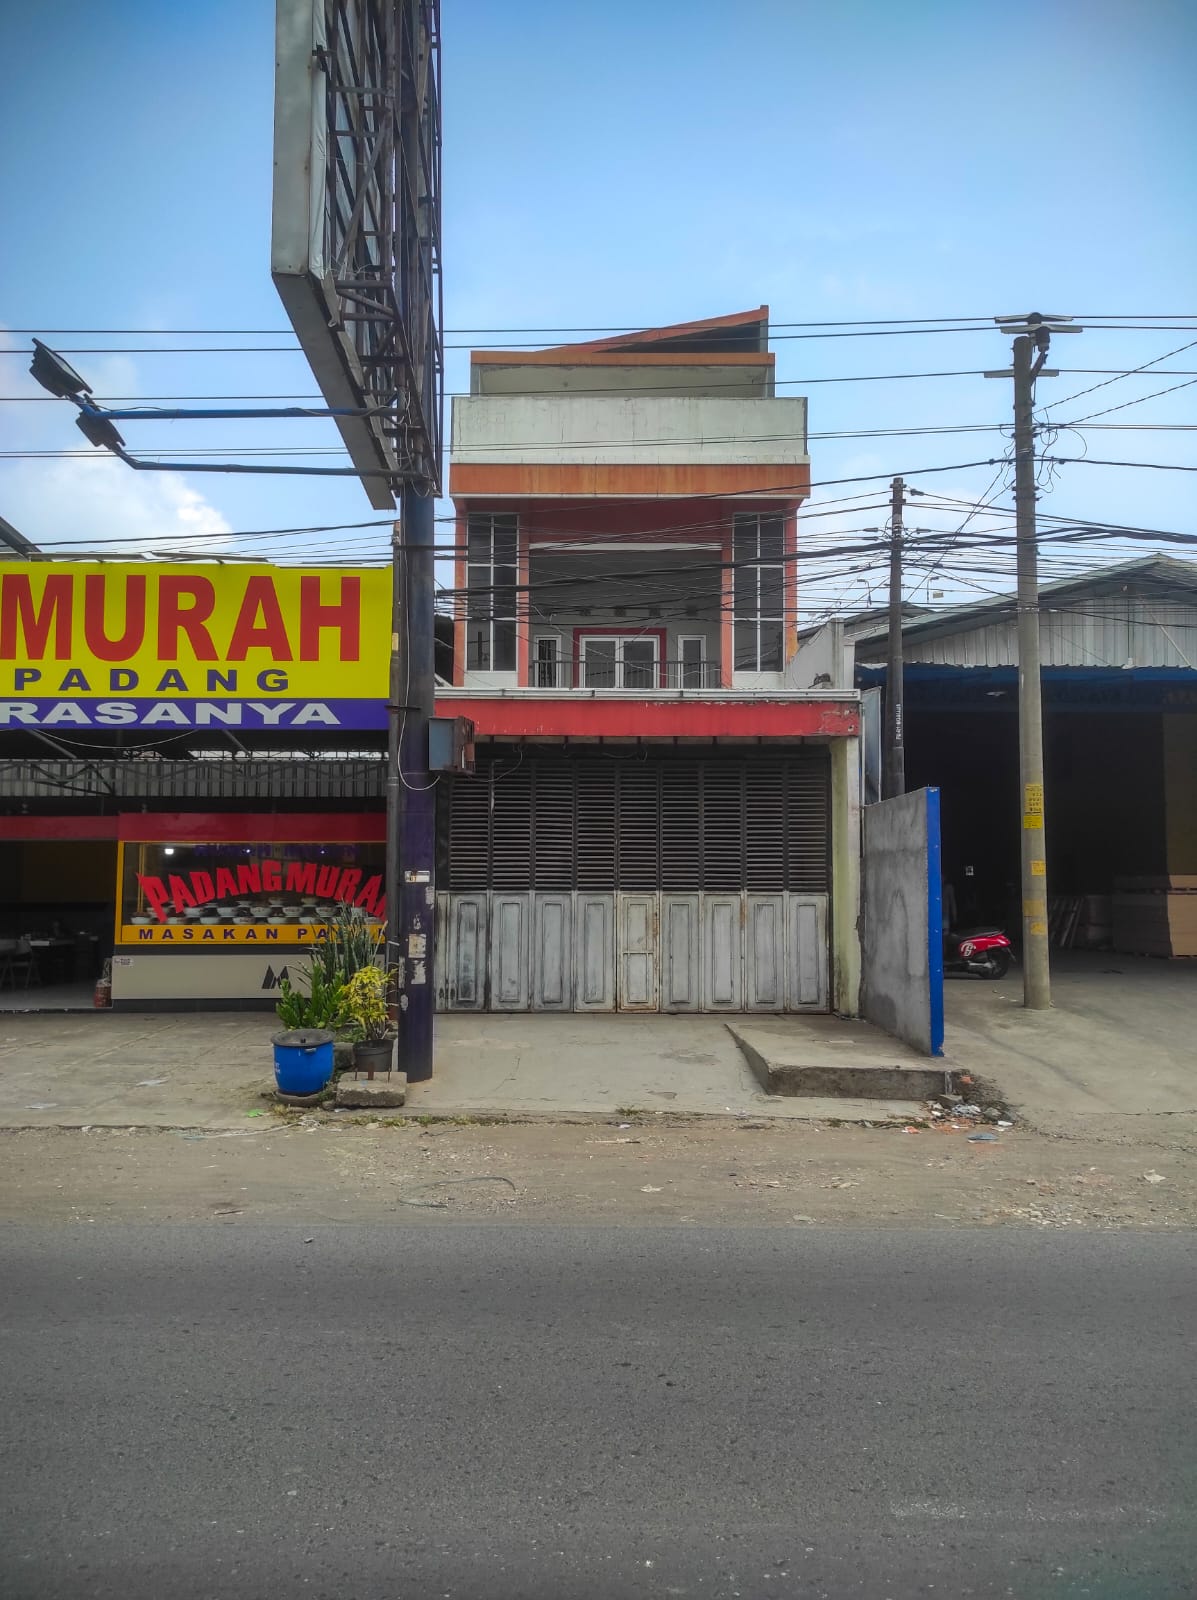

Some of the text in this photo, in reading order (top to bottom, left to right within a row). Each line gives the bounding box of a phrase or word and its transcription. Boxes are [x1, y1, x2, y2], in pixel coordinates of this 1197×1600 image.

[0, 574, 361, 662] MURAH
[14, 668, 290, 692] PADANG
[0, 702, 341, 725] RASANYA
[138, 928, 278, 940] MASAKAN
